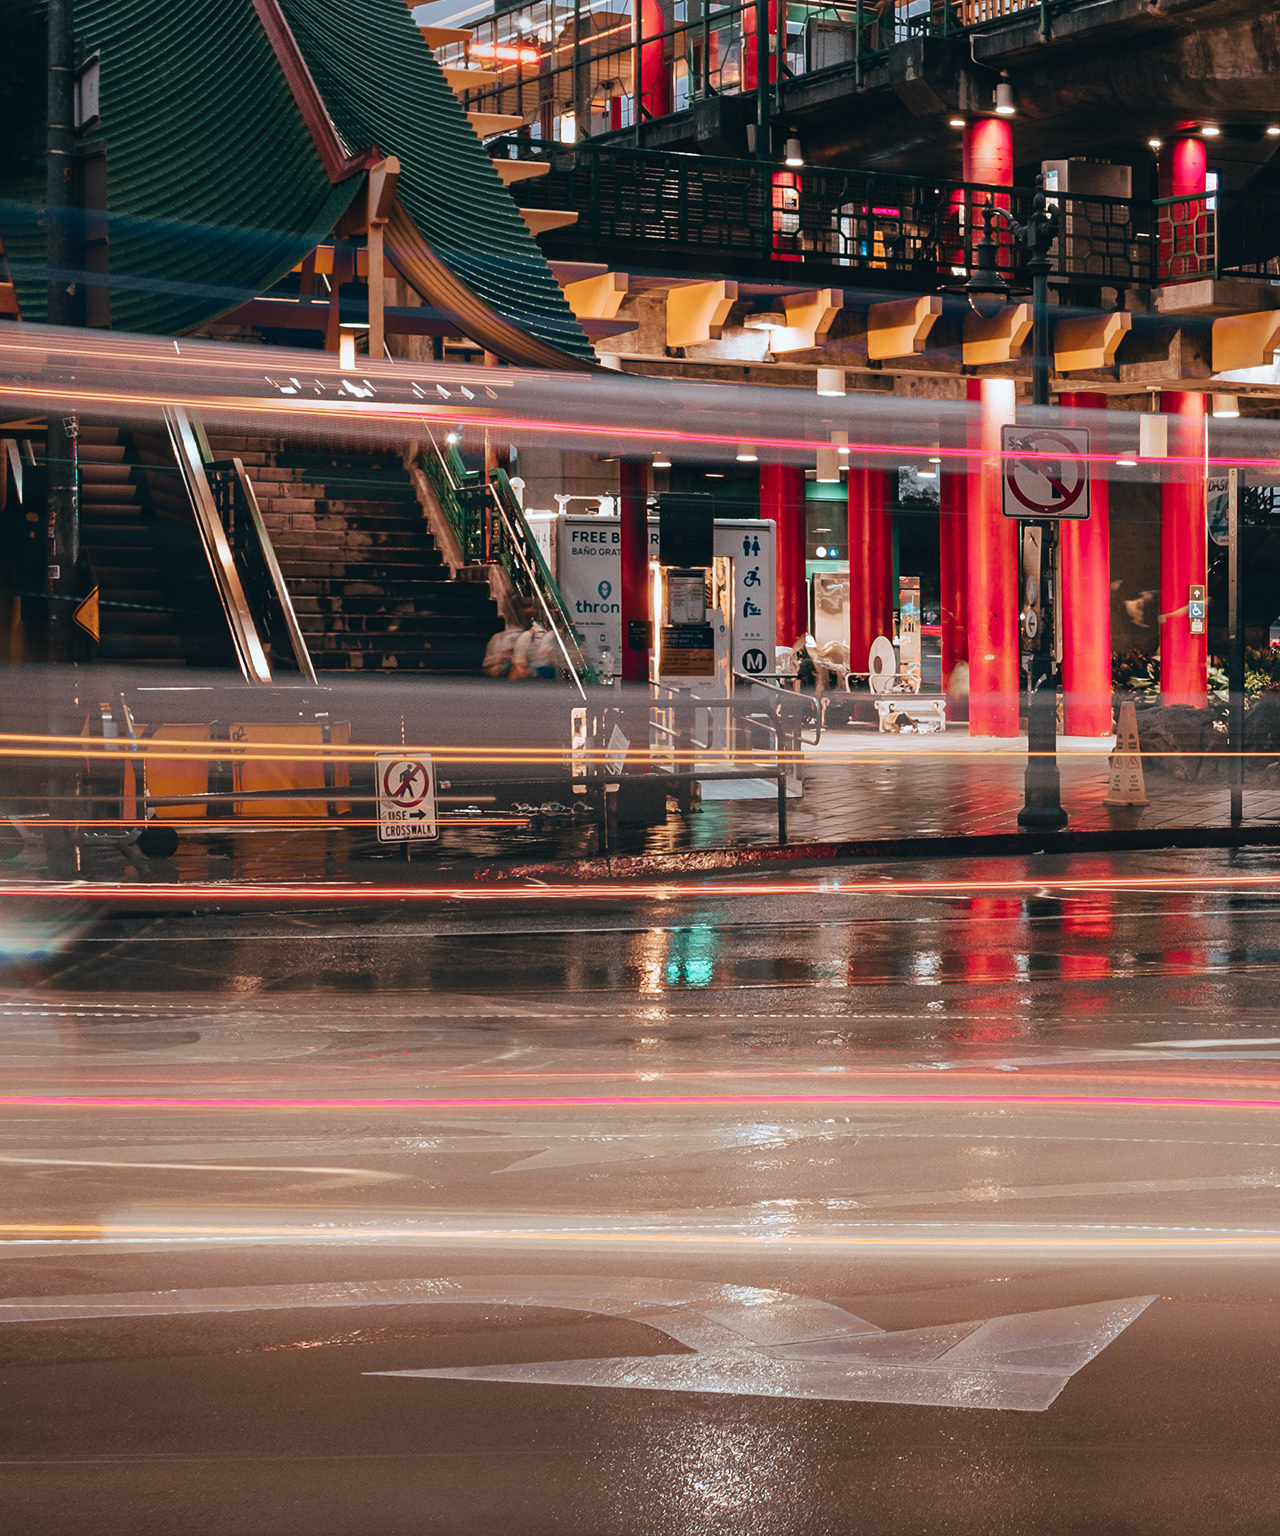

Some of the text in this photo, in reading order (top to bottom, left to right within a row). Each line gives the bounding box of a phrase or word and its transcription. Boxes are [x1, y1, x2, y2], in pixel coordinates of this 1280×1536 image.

[572, 531, 607, 543] FREE
[572, 545, 621, 556] BAÑO GRAT
[575, 600, 620, 613] thron
[747, 653, 763, 670] M
[388, 811, 408, 821] USE
[385, 824, 433, 837] CROSSWALK
